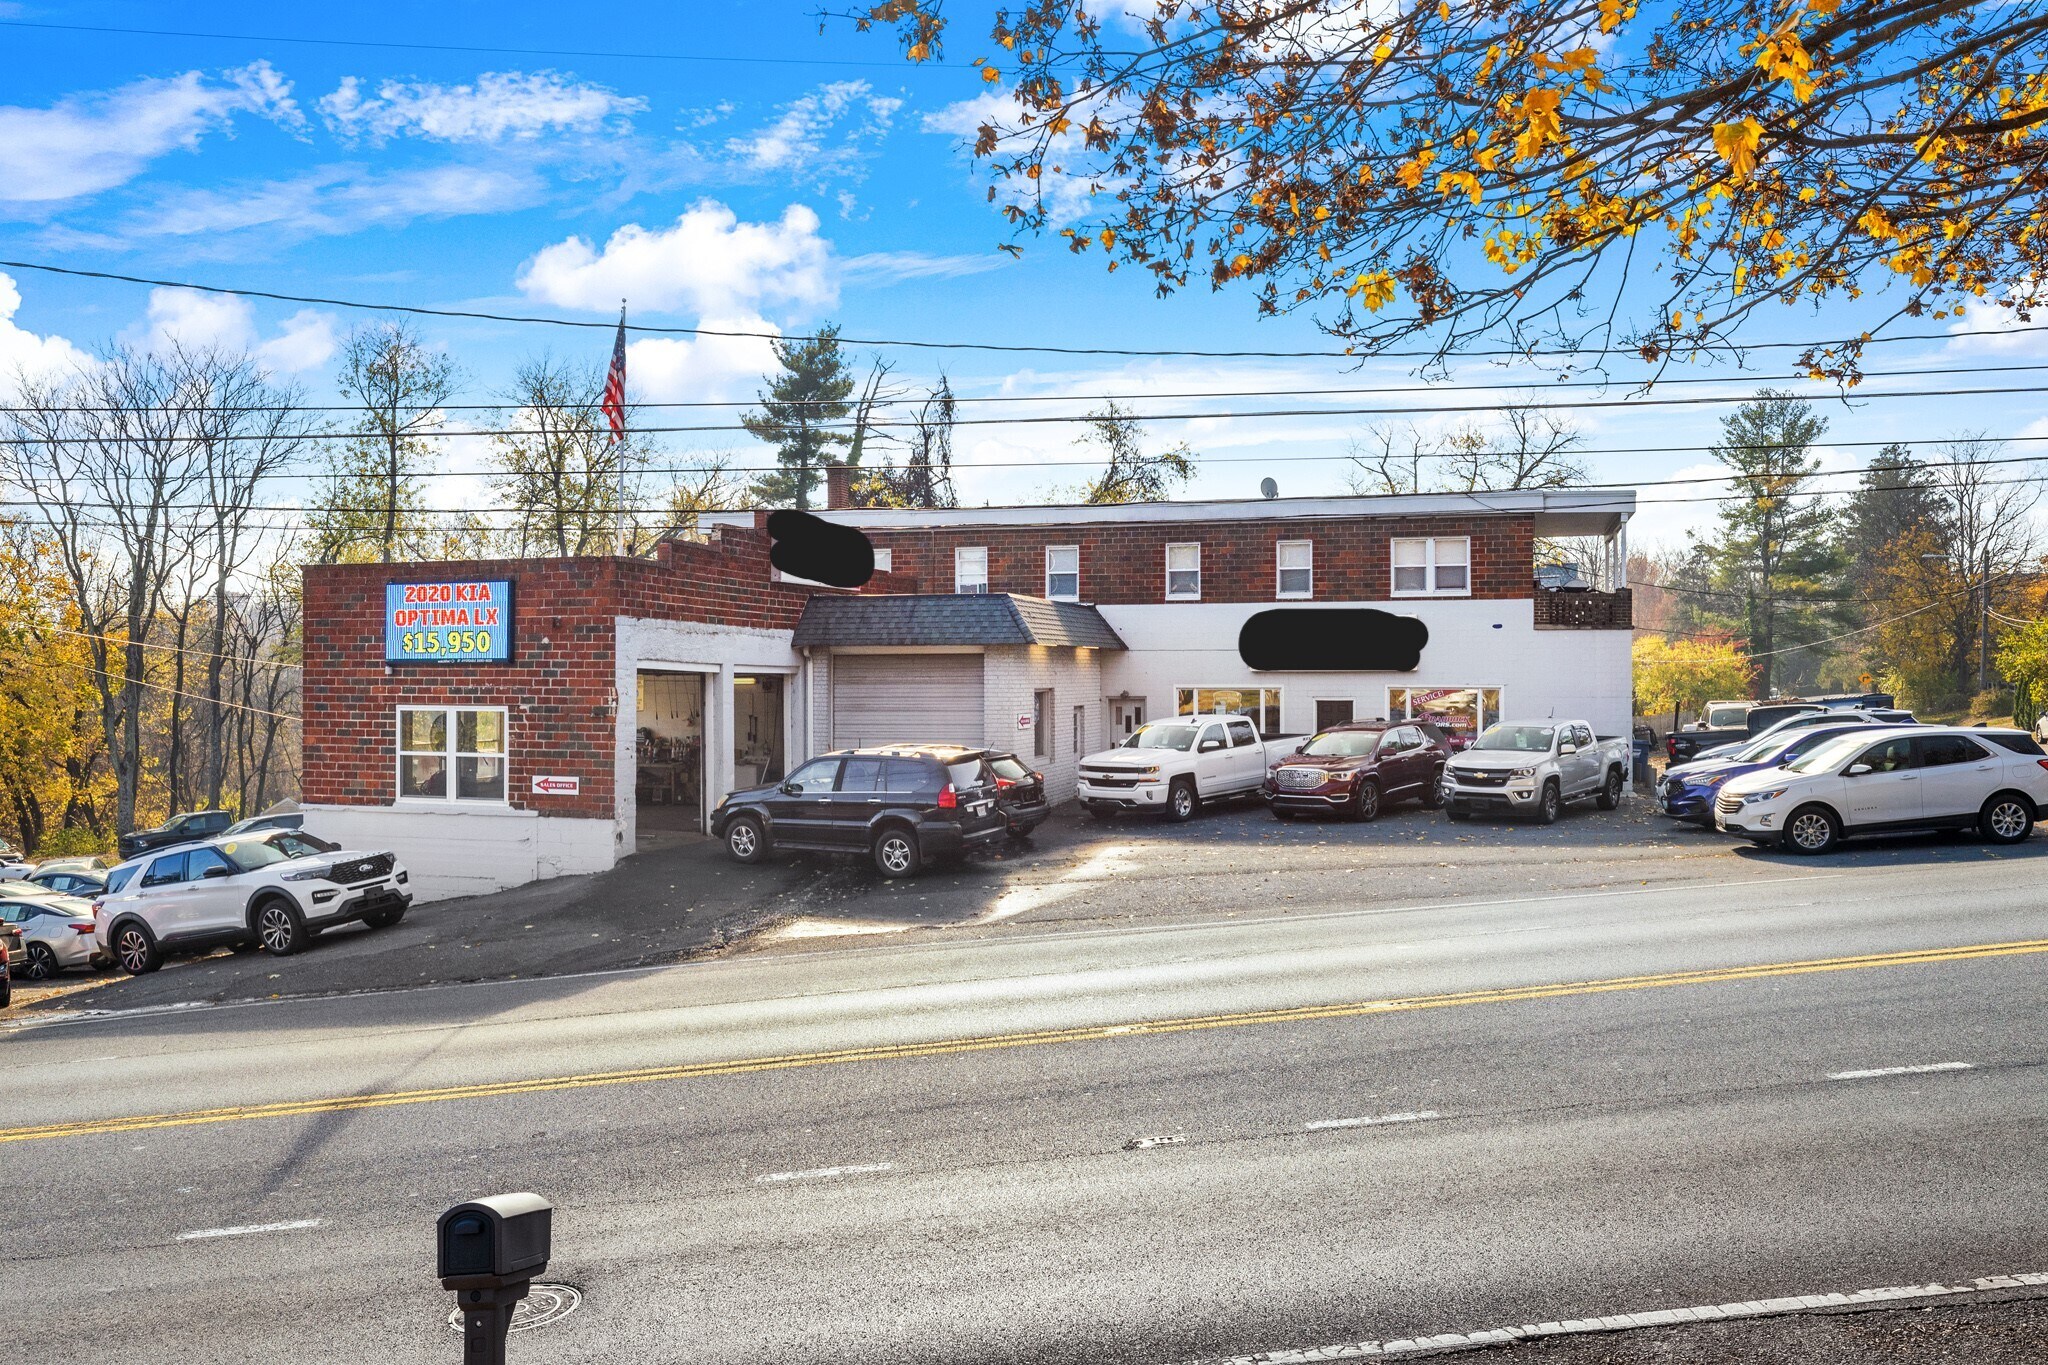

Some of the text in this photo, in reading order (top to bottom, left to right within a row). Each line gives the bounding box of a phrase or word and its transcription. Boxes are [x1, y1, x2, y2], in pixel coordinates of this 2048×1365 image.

[404, 584, 491, 604] 2020 KIA
[394, 607, 499, 627] OPTIMA LX
[402, 630, 491, 656] $15,950
[1412, 689, 1445, 706] SERVICE!
